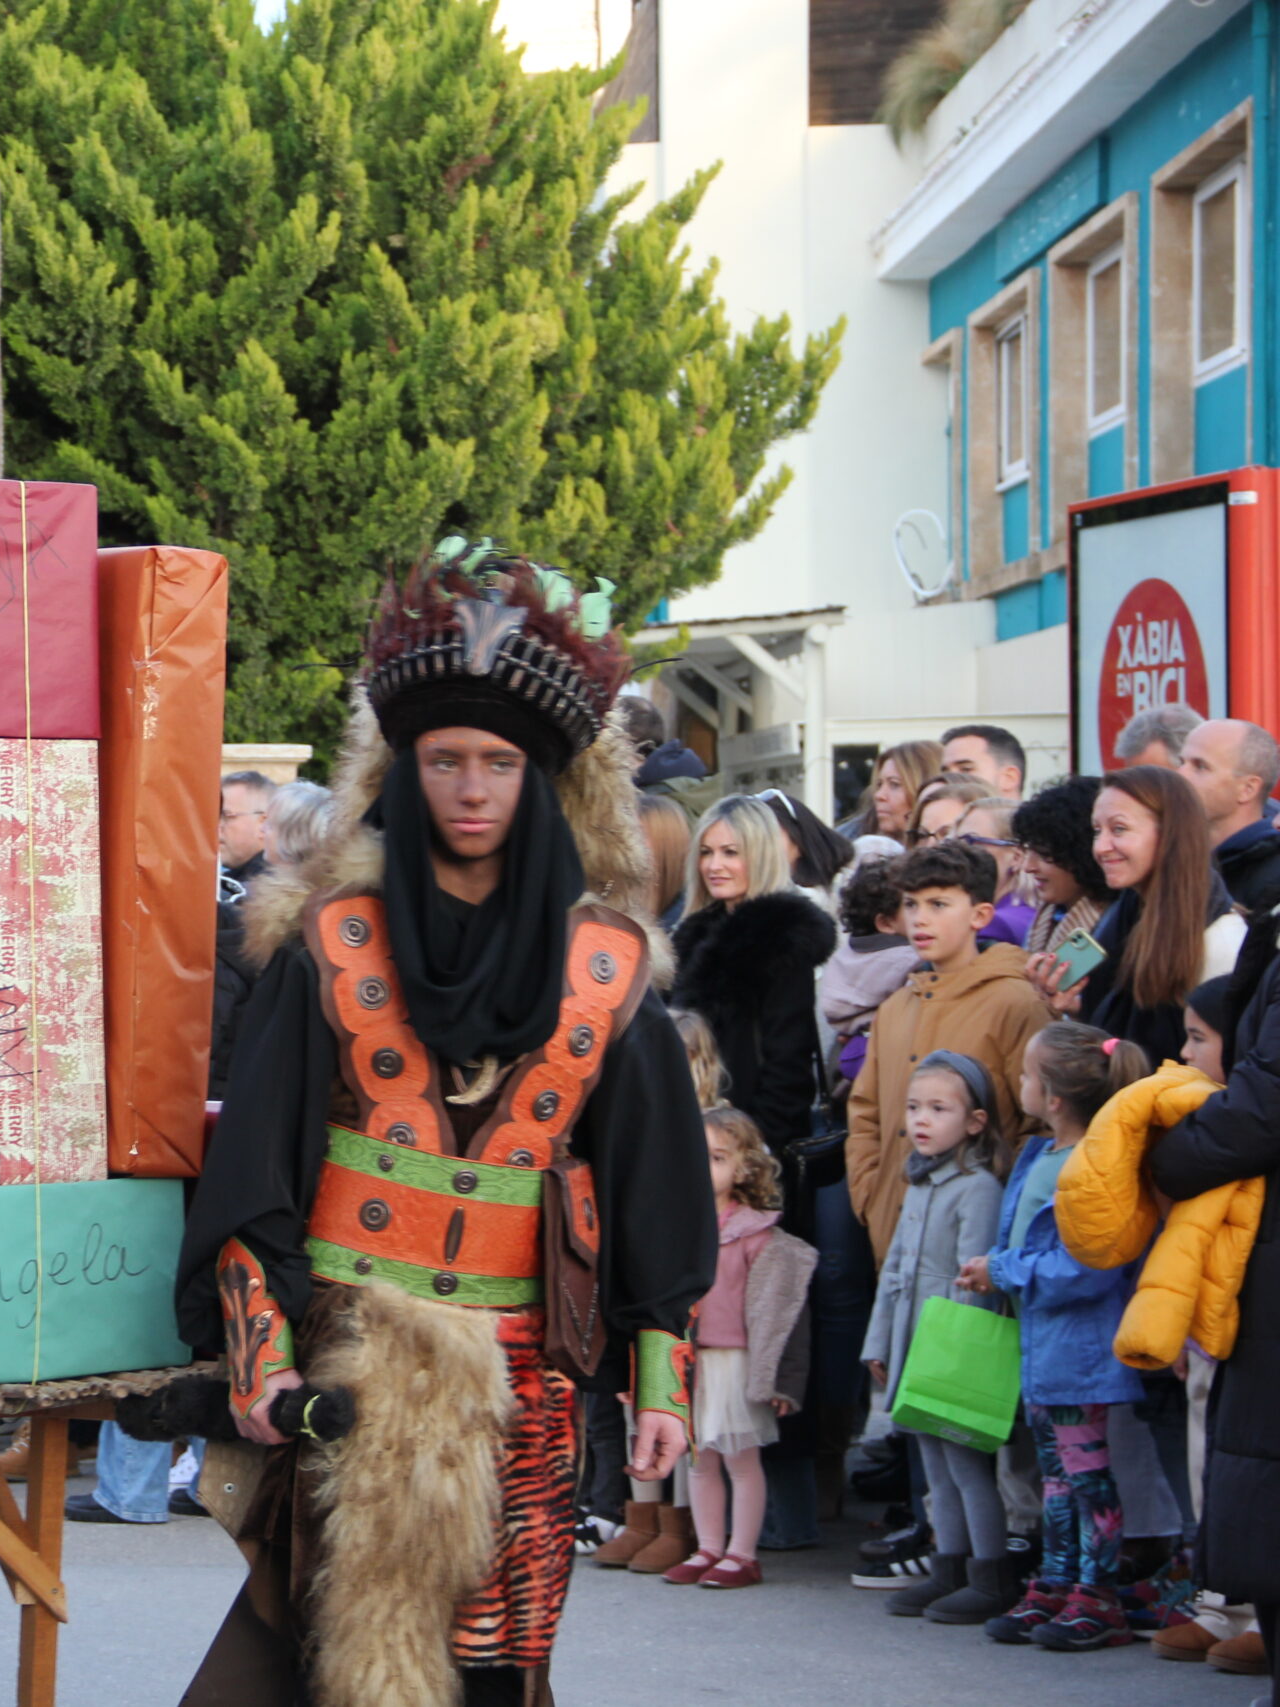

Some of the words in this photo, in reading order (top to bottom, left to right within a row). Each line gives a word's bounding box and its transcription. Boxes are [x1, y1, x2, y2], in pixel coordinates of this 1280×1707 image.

[1116, 612, 1186, 669] XÀBIA
[1116, 673, 1131, 697] EN
[1133, 666, 1186, 713] BICI
[0, 749, 14, 808] MERRY
[7, 1088, 23, 1148] MERRY
